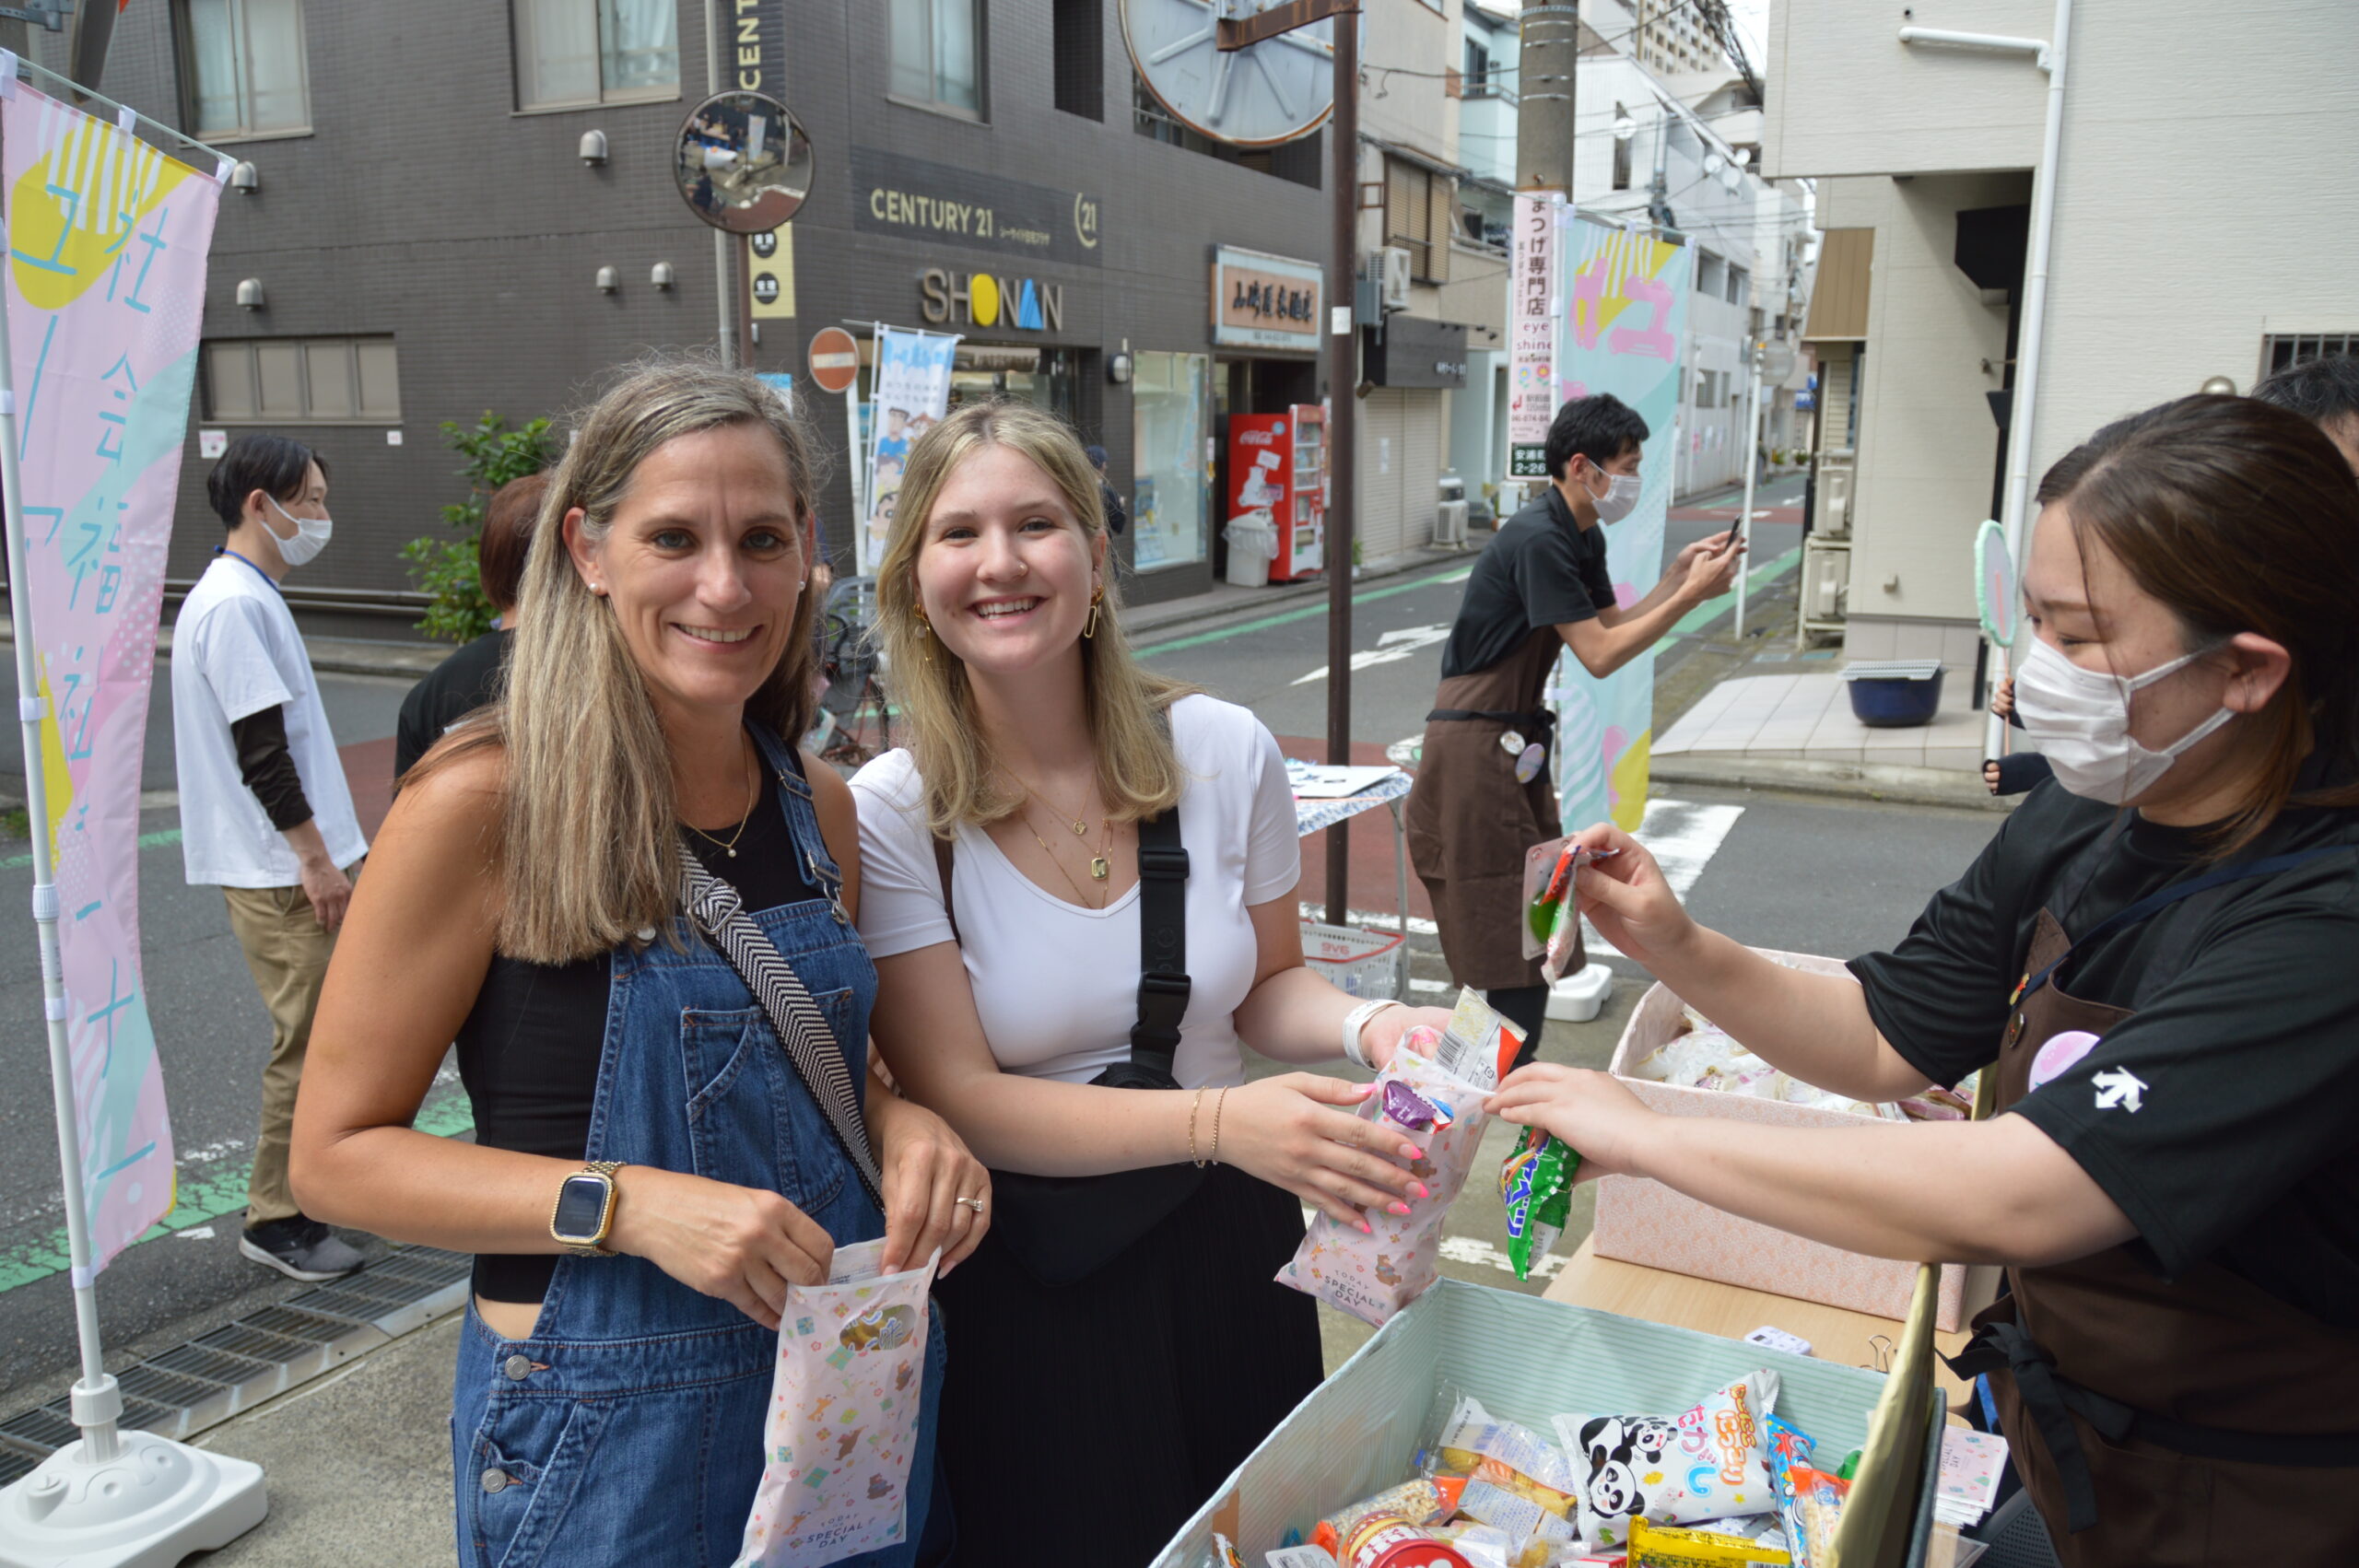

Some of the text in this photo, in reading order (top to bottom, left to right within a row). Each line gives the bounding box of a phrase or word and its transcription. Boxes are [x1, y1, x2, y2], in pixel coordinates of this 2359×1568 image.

[871, 188, 993, 239] CENTURY 21
[922, 267, 1062, 331] SHONAN
[1523, 322, 1549, 333] eye
[1324, 1275, 1375, 1306] SPECIAL
[1335, 1270, 1369, 1290] TODAY
[1334, 1290, 1361, 1306] DAY
[806, 1521, 863, 1544] SPECIAL
[819, 1534, 848, 1549] DAY
